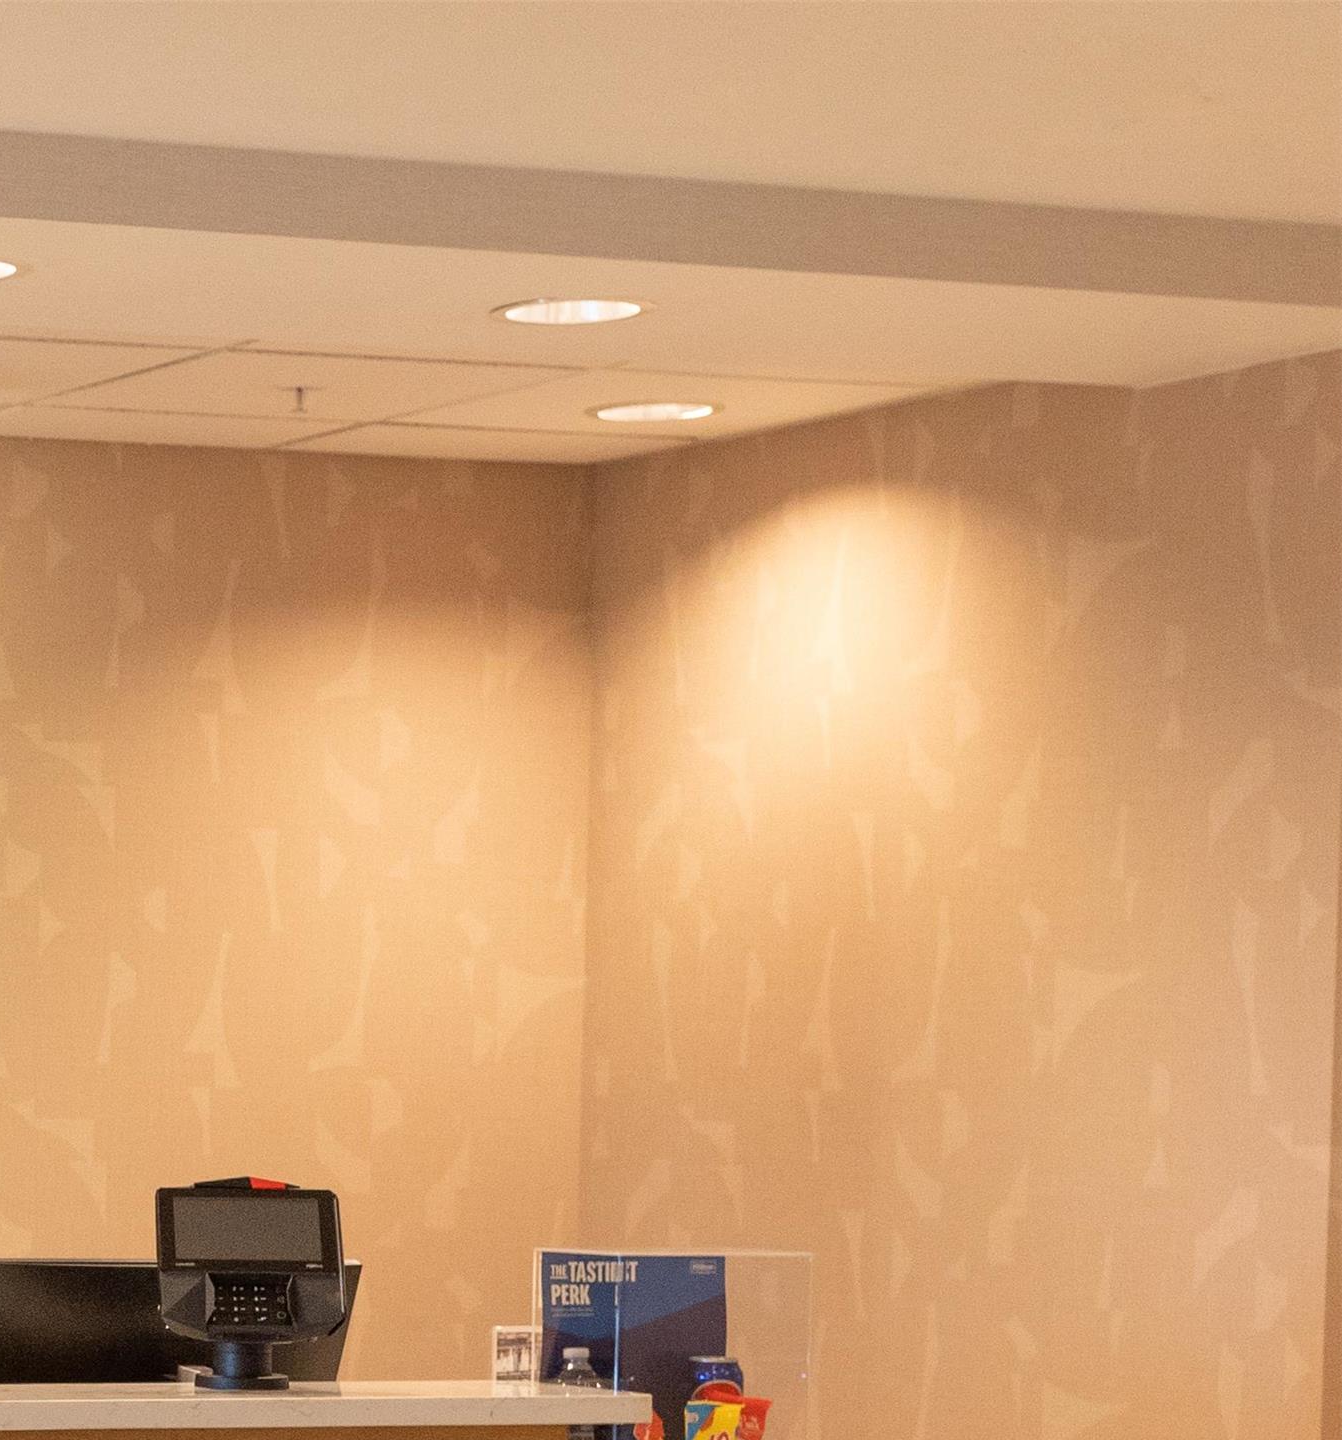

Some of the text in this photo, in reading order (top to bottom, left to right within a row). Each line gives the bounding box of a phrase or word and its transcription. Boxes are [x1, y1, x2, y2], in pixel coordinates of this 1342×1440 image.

[550, 1261, 638, 1283] THE TASTIT
[550, 1284, 591, 1306] PERK
